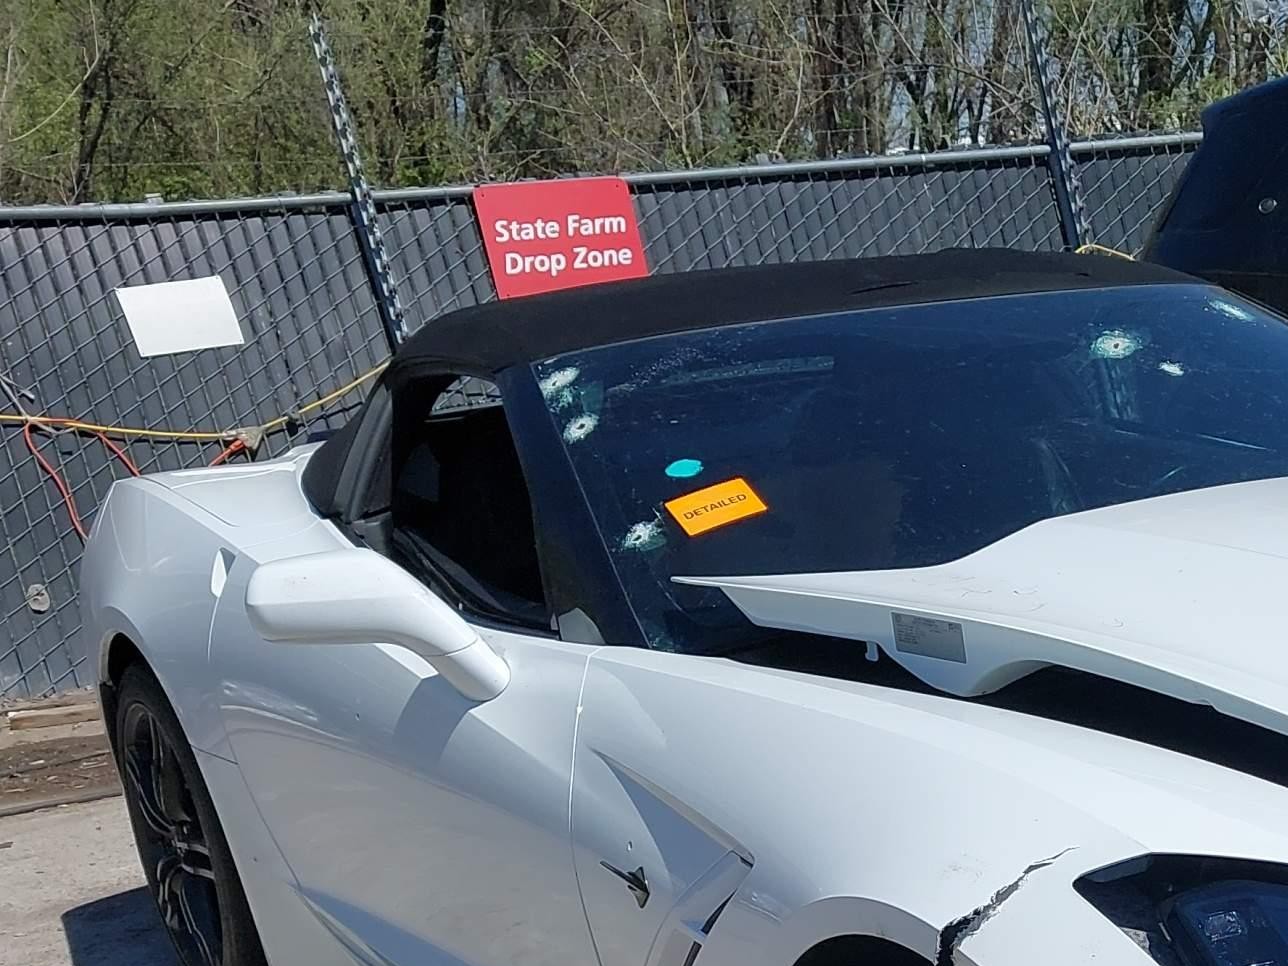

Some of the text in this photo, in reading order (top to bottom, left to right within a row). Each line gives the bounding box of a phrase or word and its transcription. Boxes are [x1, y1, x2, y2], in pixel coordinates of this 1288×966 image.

[495, 214, 626, 242] State Farm
[505, 247, 632, 276] Drop Zone
[683, 493, 747, 520] DETAILED
